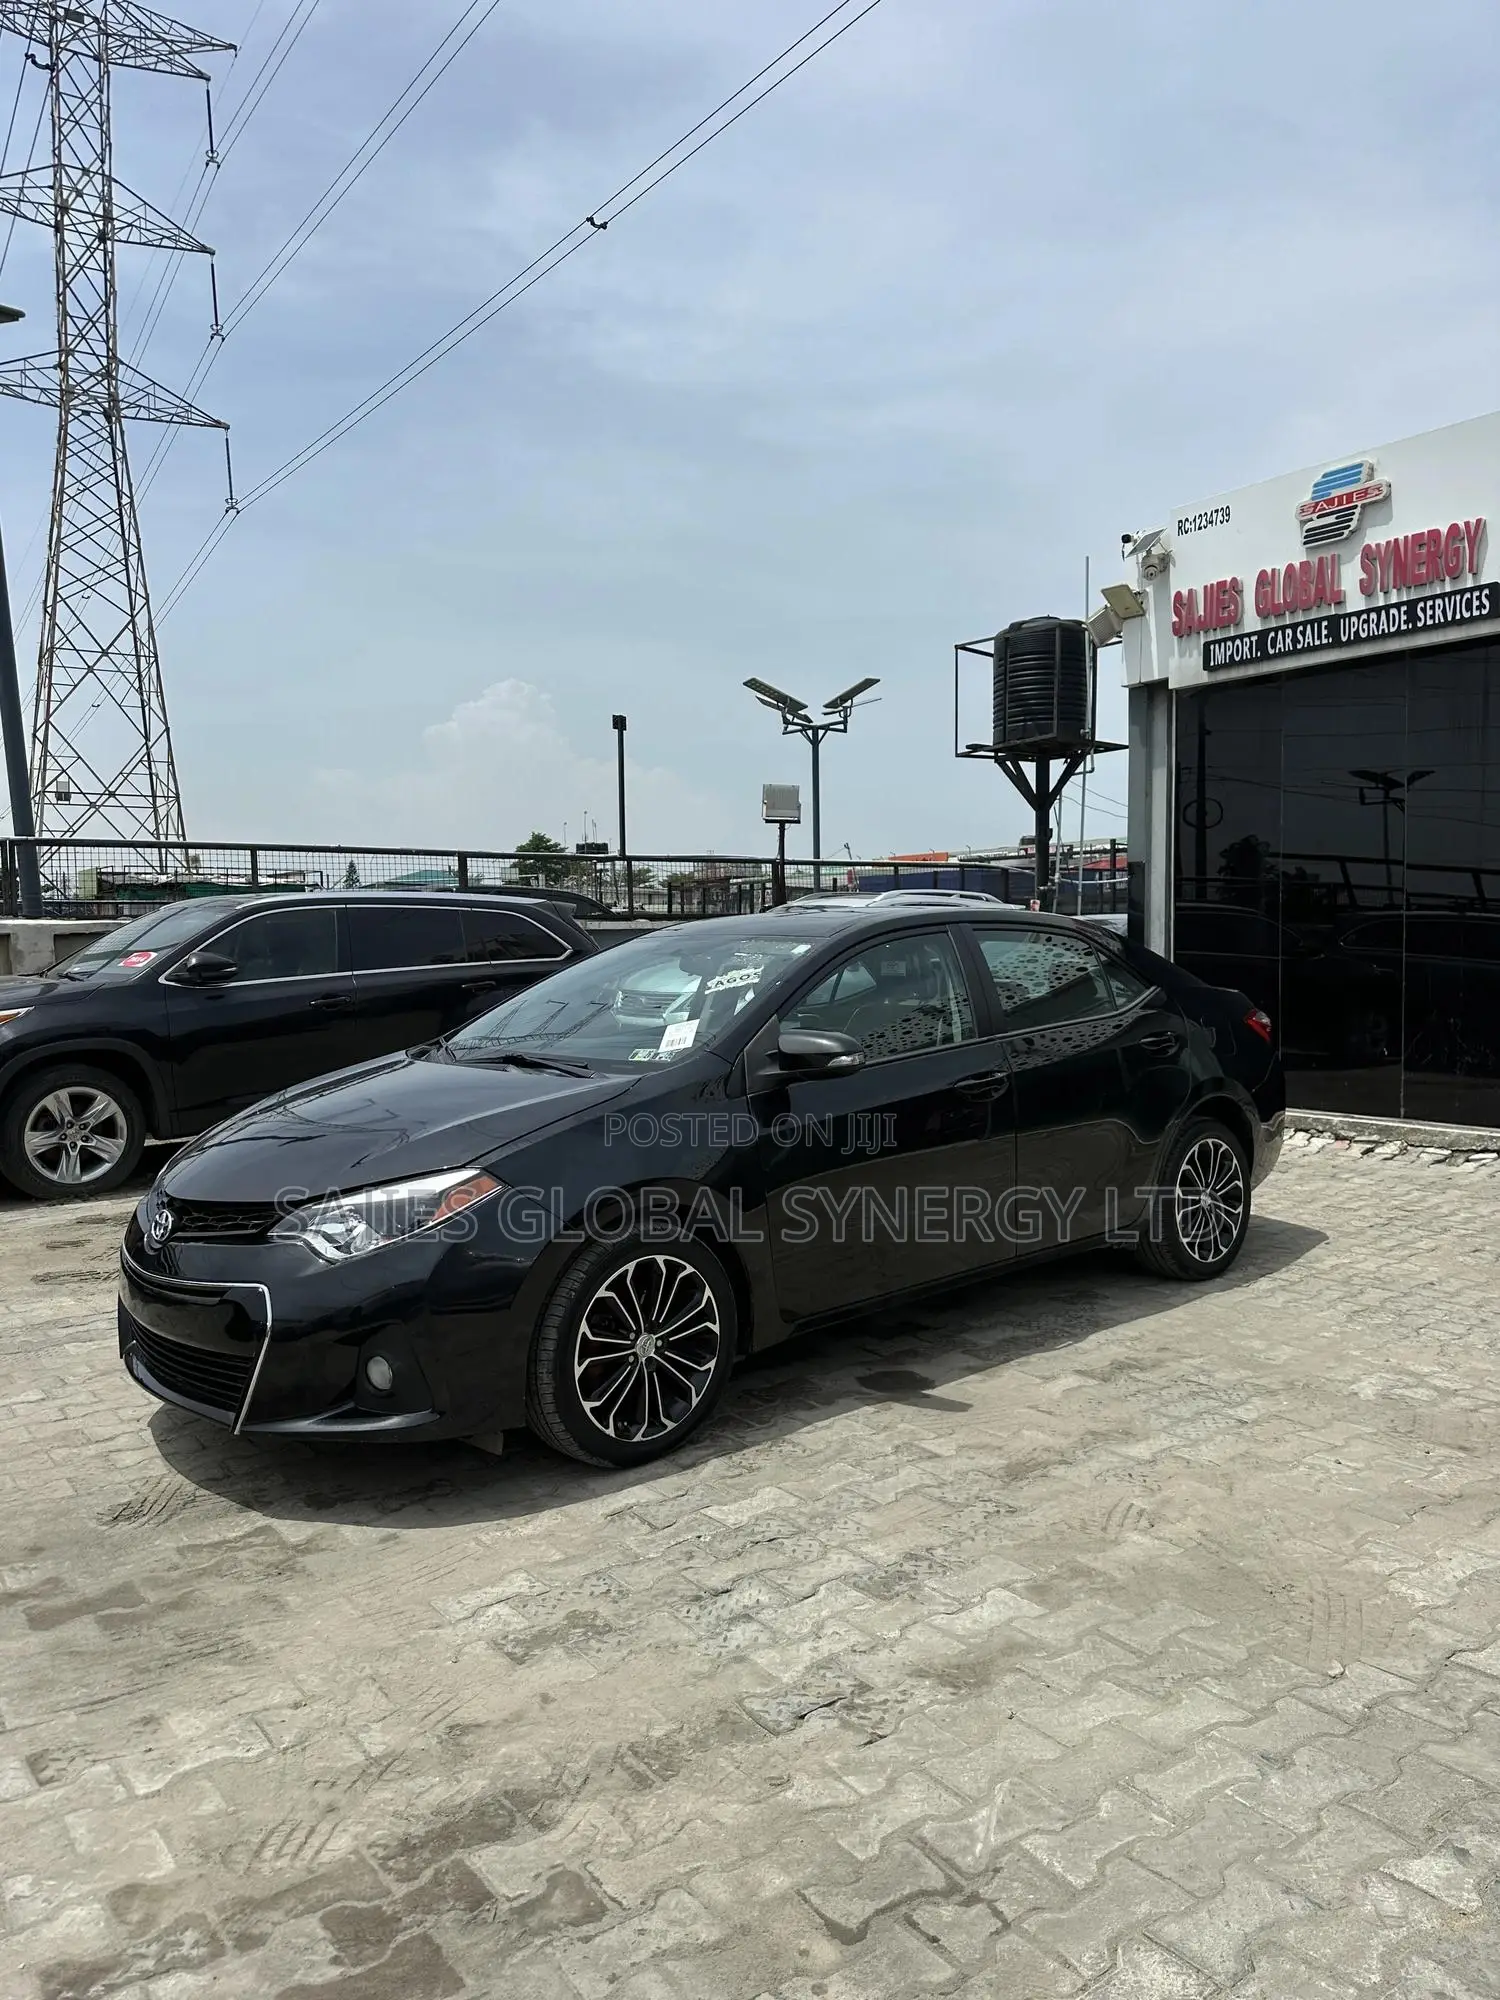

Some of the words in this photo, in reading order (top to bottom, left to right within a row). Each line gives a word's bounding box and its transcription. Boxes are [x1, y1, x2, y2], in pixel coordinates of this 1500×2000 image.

[1177, 505, 1231, 537] RC:1234739
[1299, 483, 1384, 518] SAJIES
[1172, 577, 1242, 638] SAJIES
[1255, 553, 1344, 619] GLOBAL
[1359, 518, 1486, 597] SYNERGY
[1210, 634, 1261, 667] IMPORT.
[1267, 627, 1293, 655] CAR
[1296, 620, 1333, 649] SALE.
[1340, 605, 1412, 642] UPGRADE.
[1416, 588, 1490, 628] SERVICES
